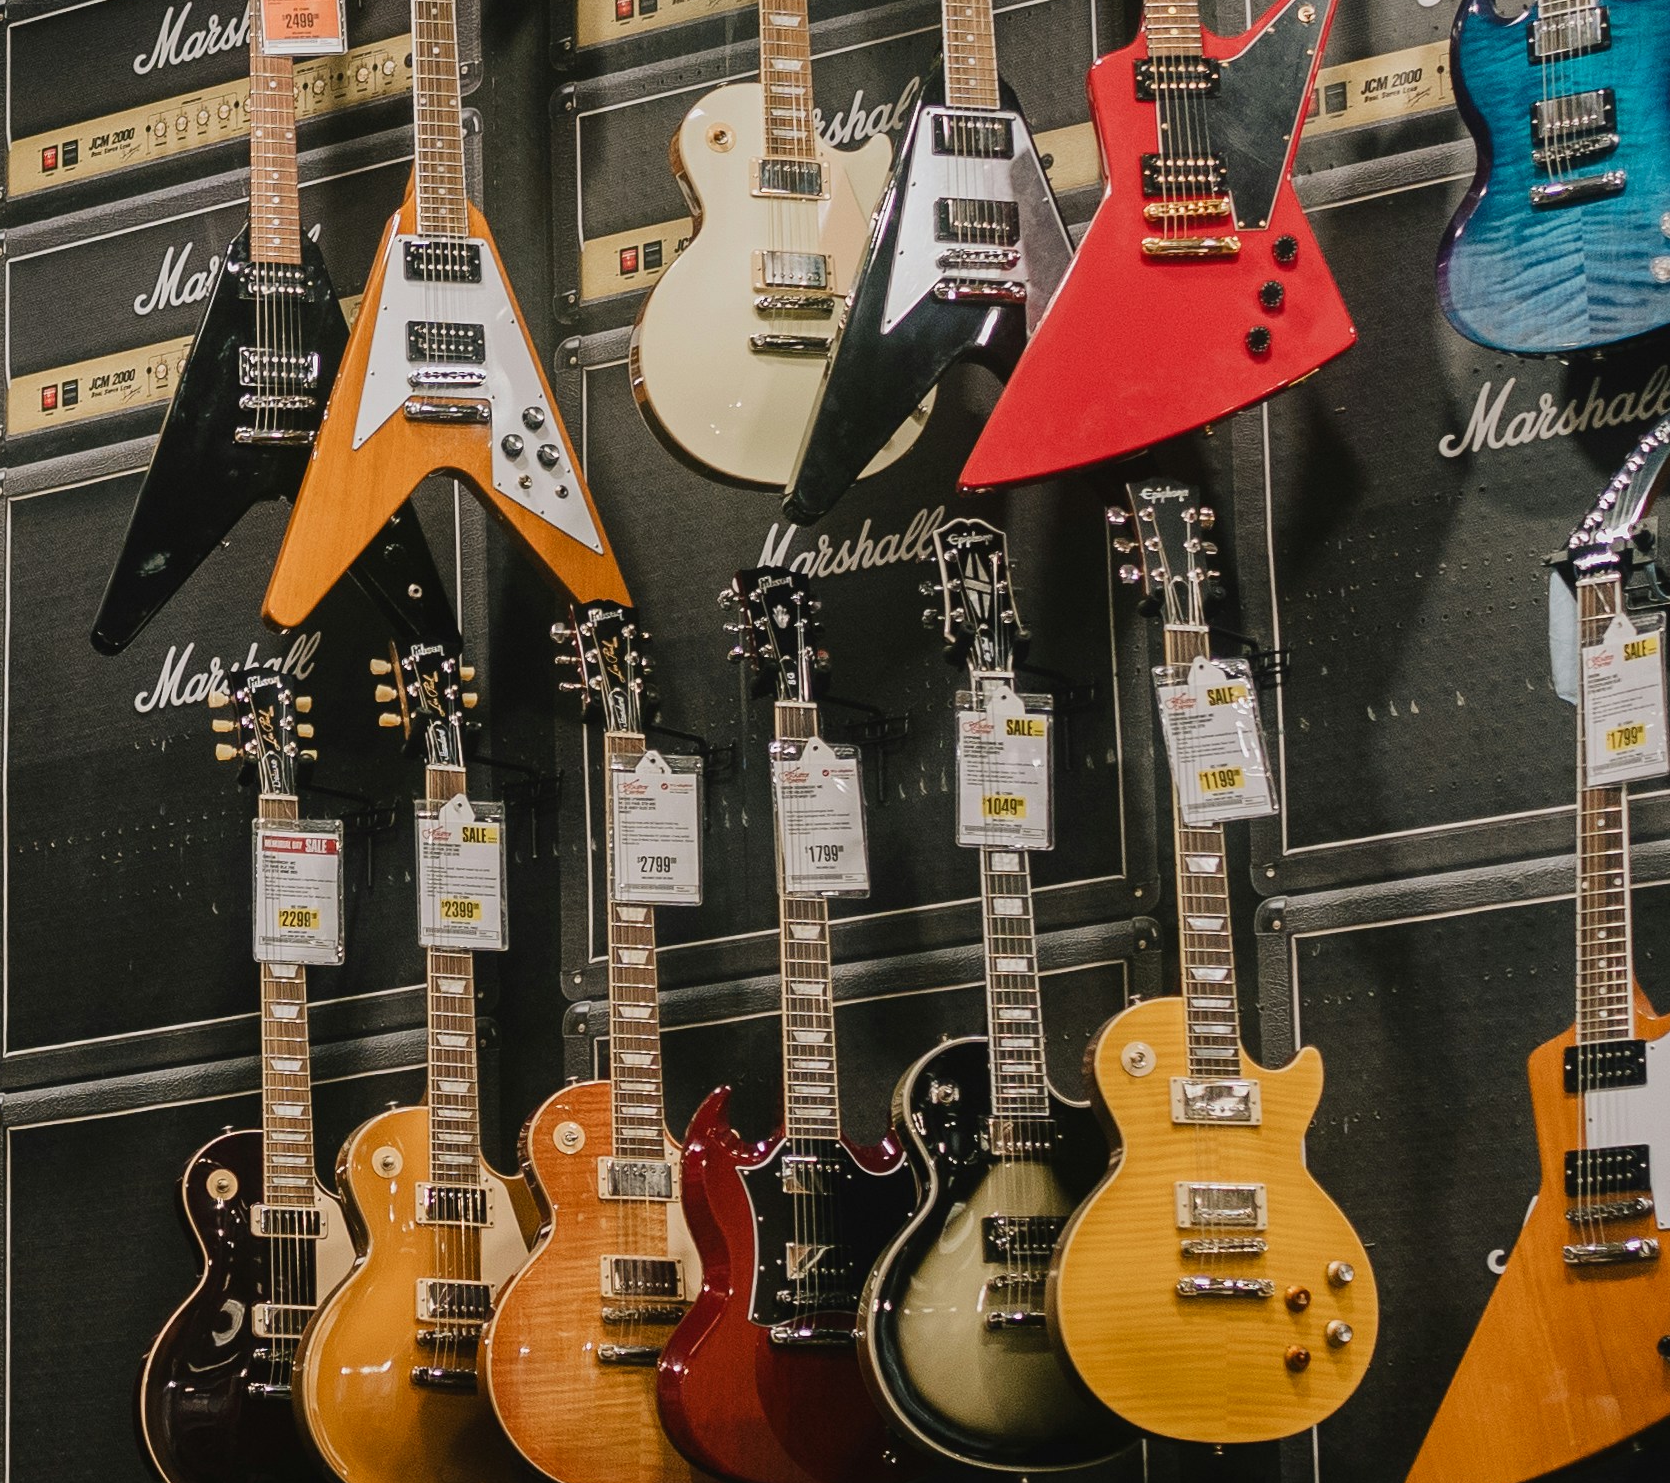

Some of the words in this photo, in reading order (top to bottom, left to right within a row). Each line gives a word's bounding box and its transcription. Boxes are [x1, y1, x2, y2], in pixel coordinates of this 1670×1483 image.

[1360, 75, 1389, 95] JCM
[1392, 68, 1423, 88] 2000
[89, 134, 111, 150] JCM
[111, 127, 136, 145] 2000
[89, 375, 111, 391] JCM
[111, 369, 136, 386] 2000
[758, 576, 792, 592] Gibson
[588, 608, 624, 626] Gibson
[411, 643, 444, 658] Gibson
[1623, 642, 1648, 662] SALE
[247, 675, 283, 693] Gibson
[1206, 687, 1234, 707] SALE
[1006, 719, 1032, 735] SALE
[463, 826, 487, 843] SALE
[305, 839, 328, 854] SALE
